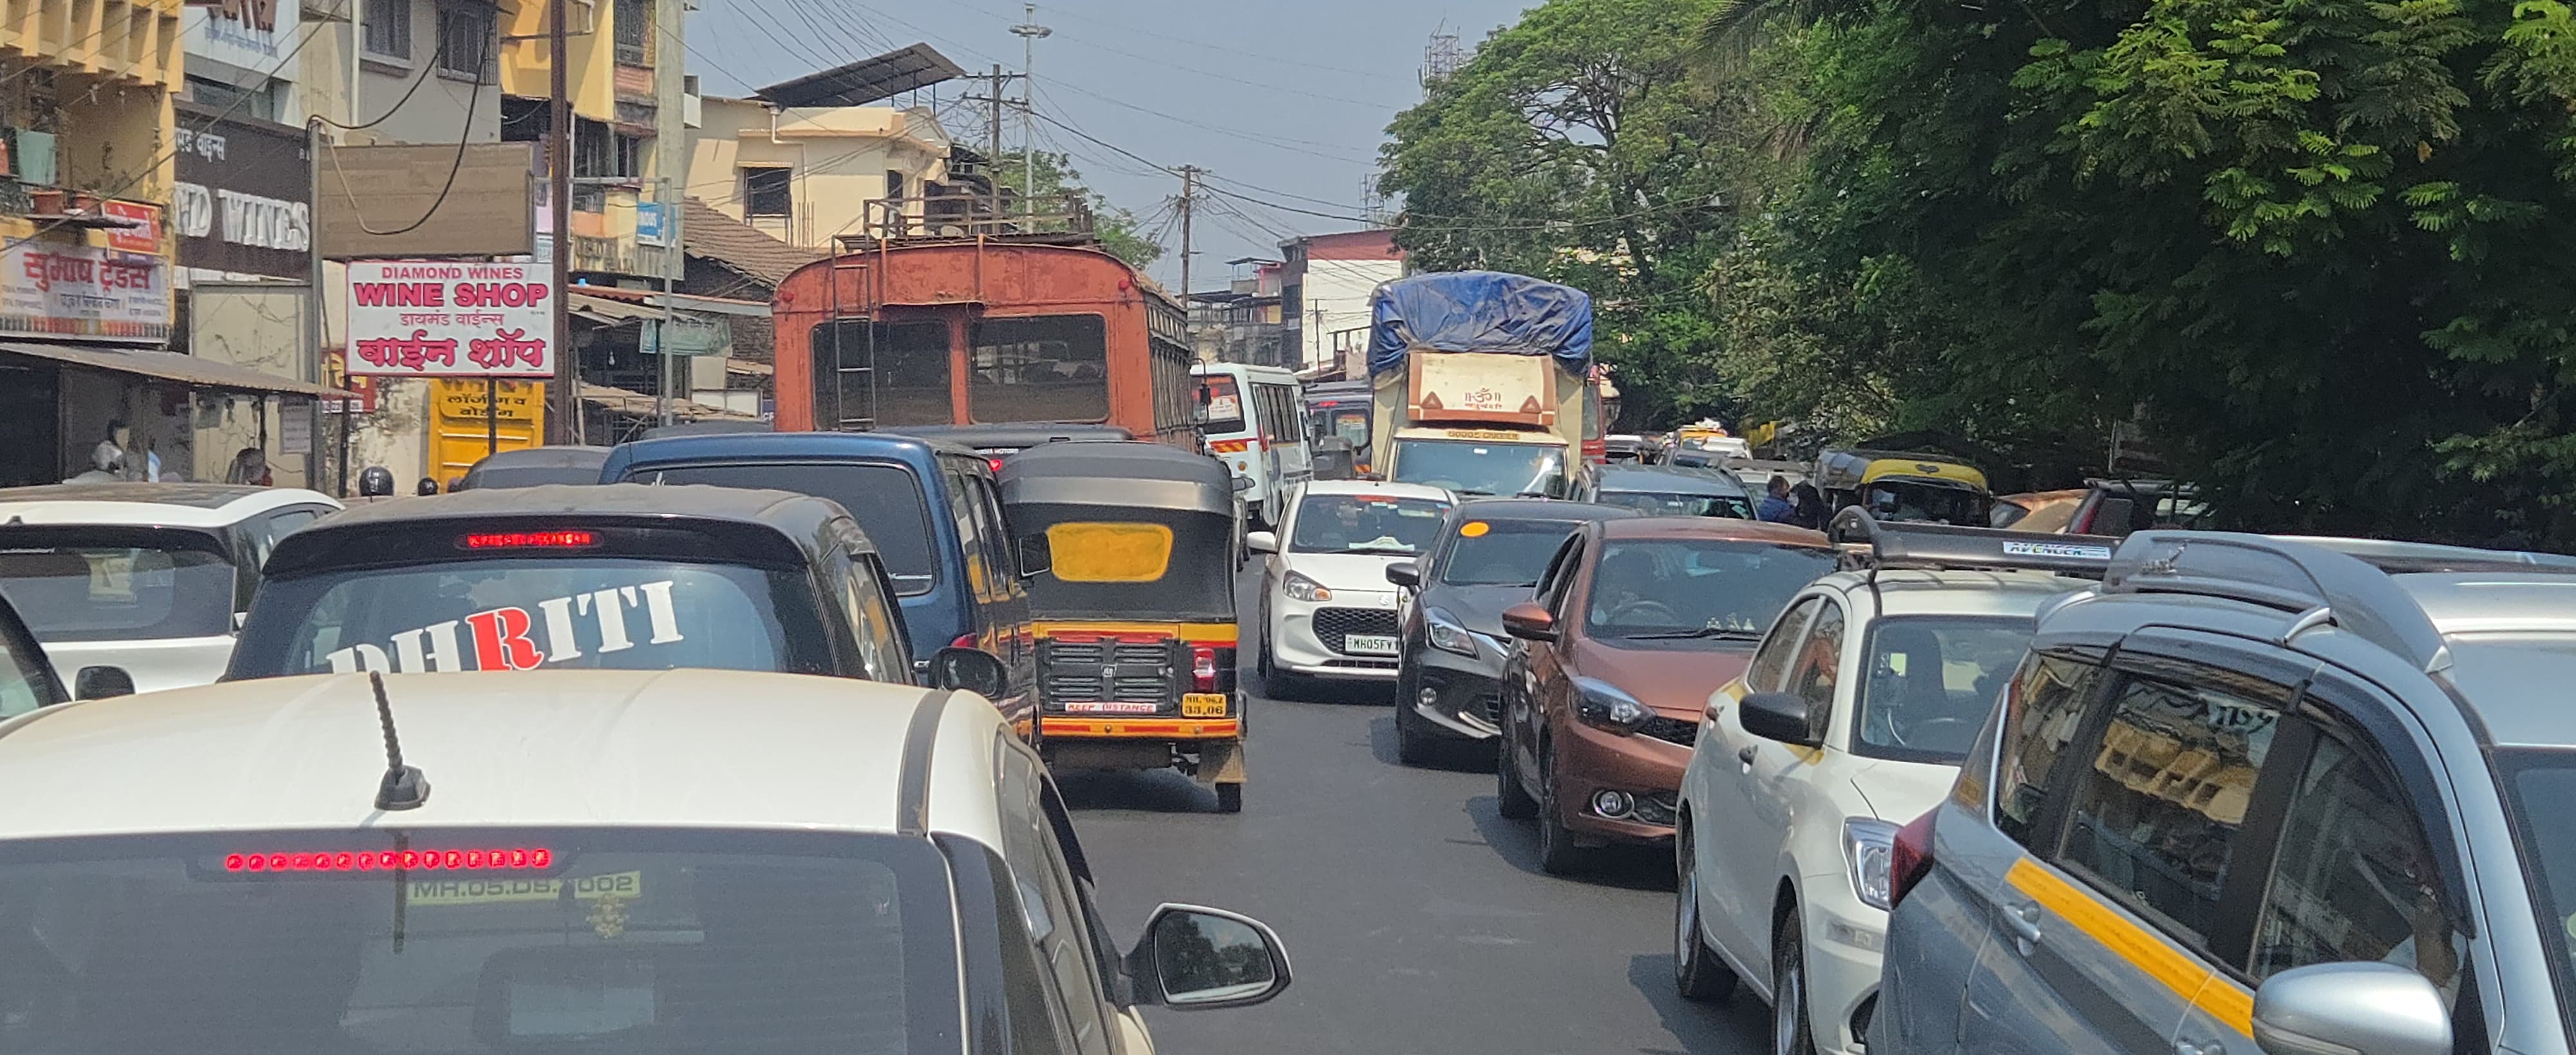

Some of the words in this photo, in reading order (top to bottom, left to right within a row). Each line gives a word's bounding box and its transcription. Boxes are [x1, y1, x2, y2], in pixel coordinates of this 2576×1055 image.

[218, 188, 310, 253] WINES
[381, 267, 463, 279] DIAMOND
[468, 267, 524, 279] WINES
[354, 283, 444, 307] WINE
[454, 283, 548, 307] SHOP
[399, 310, 450, 326] डायमंड
[455, 309, 505, 329] वाईन्स
[468, 328, 546, 369] शॉप
[1068, 703, 1095, 711] KEEP
[1102, 703, 1153, 712] DISTANCE
